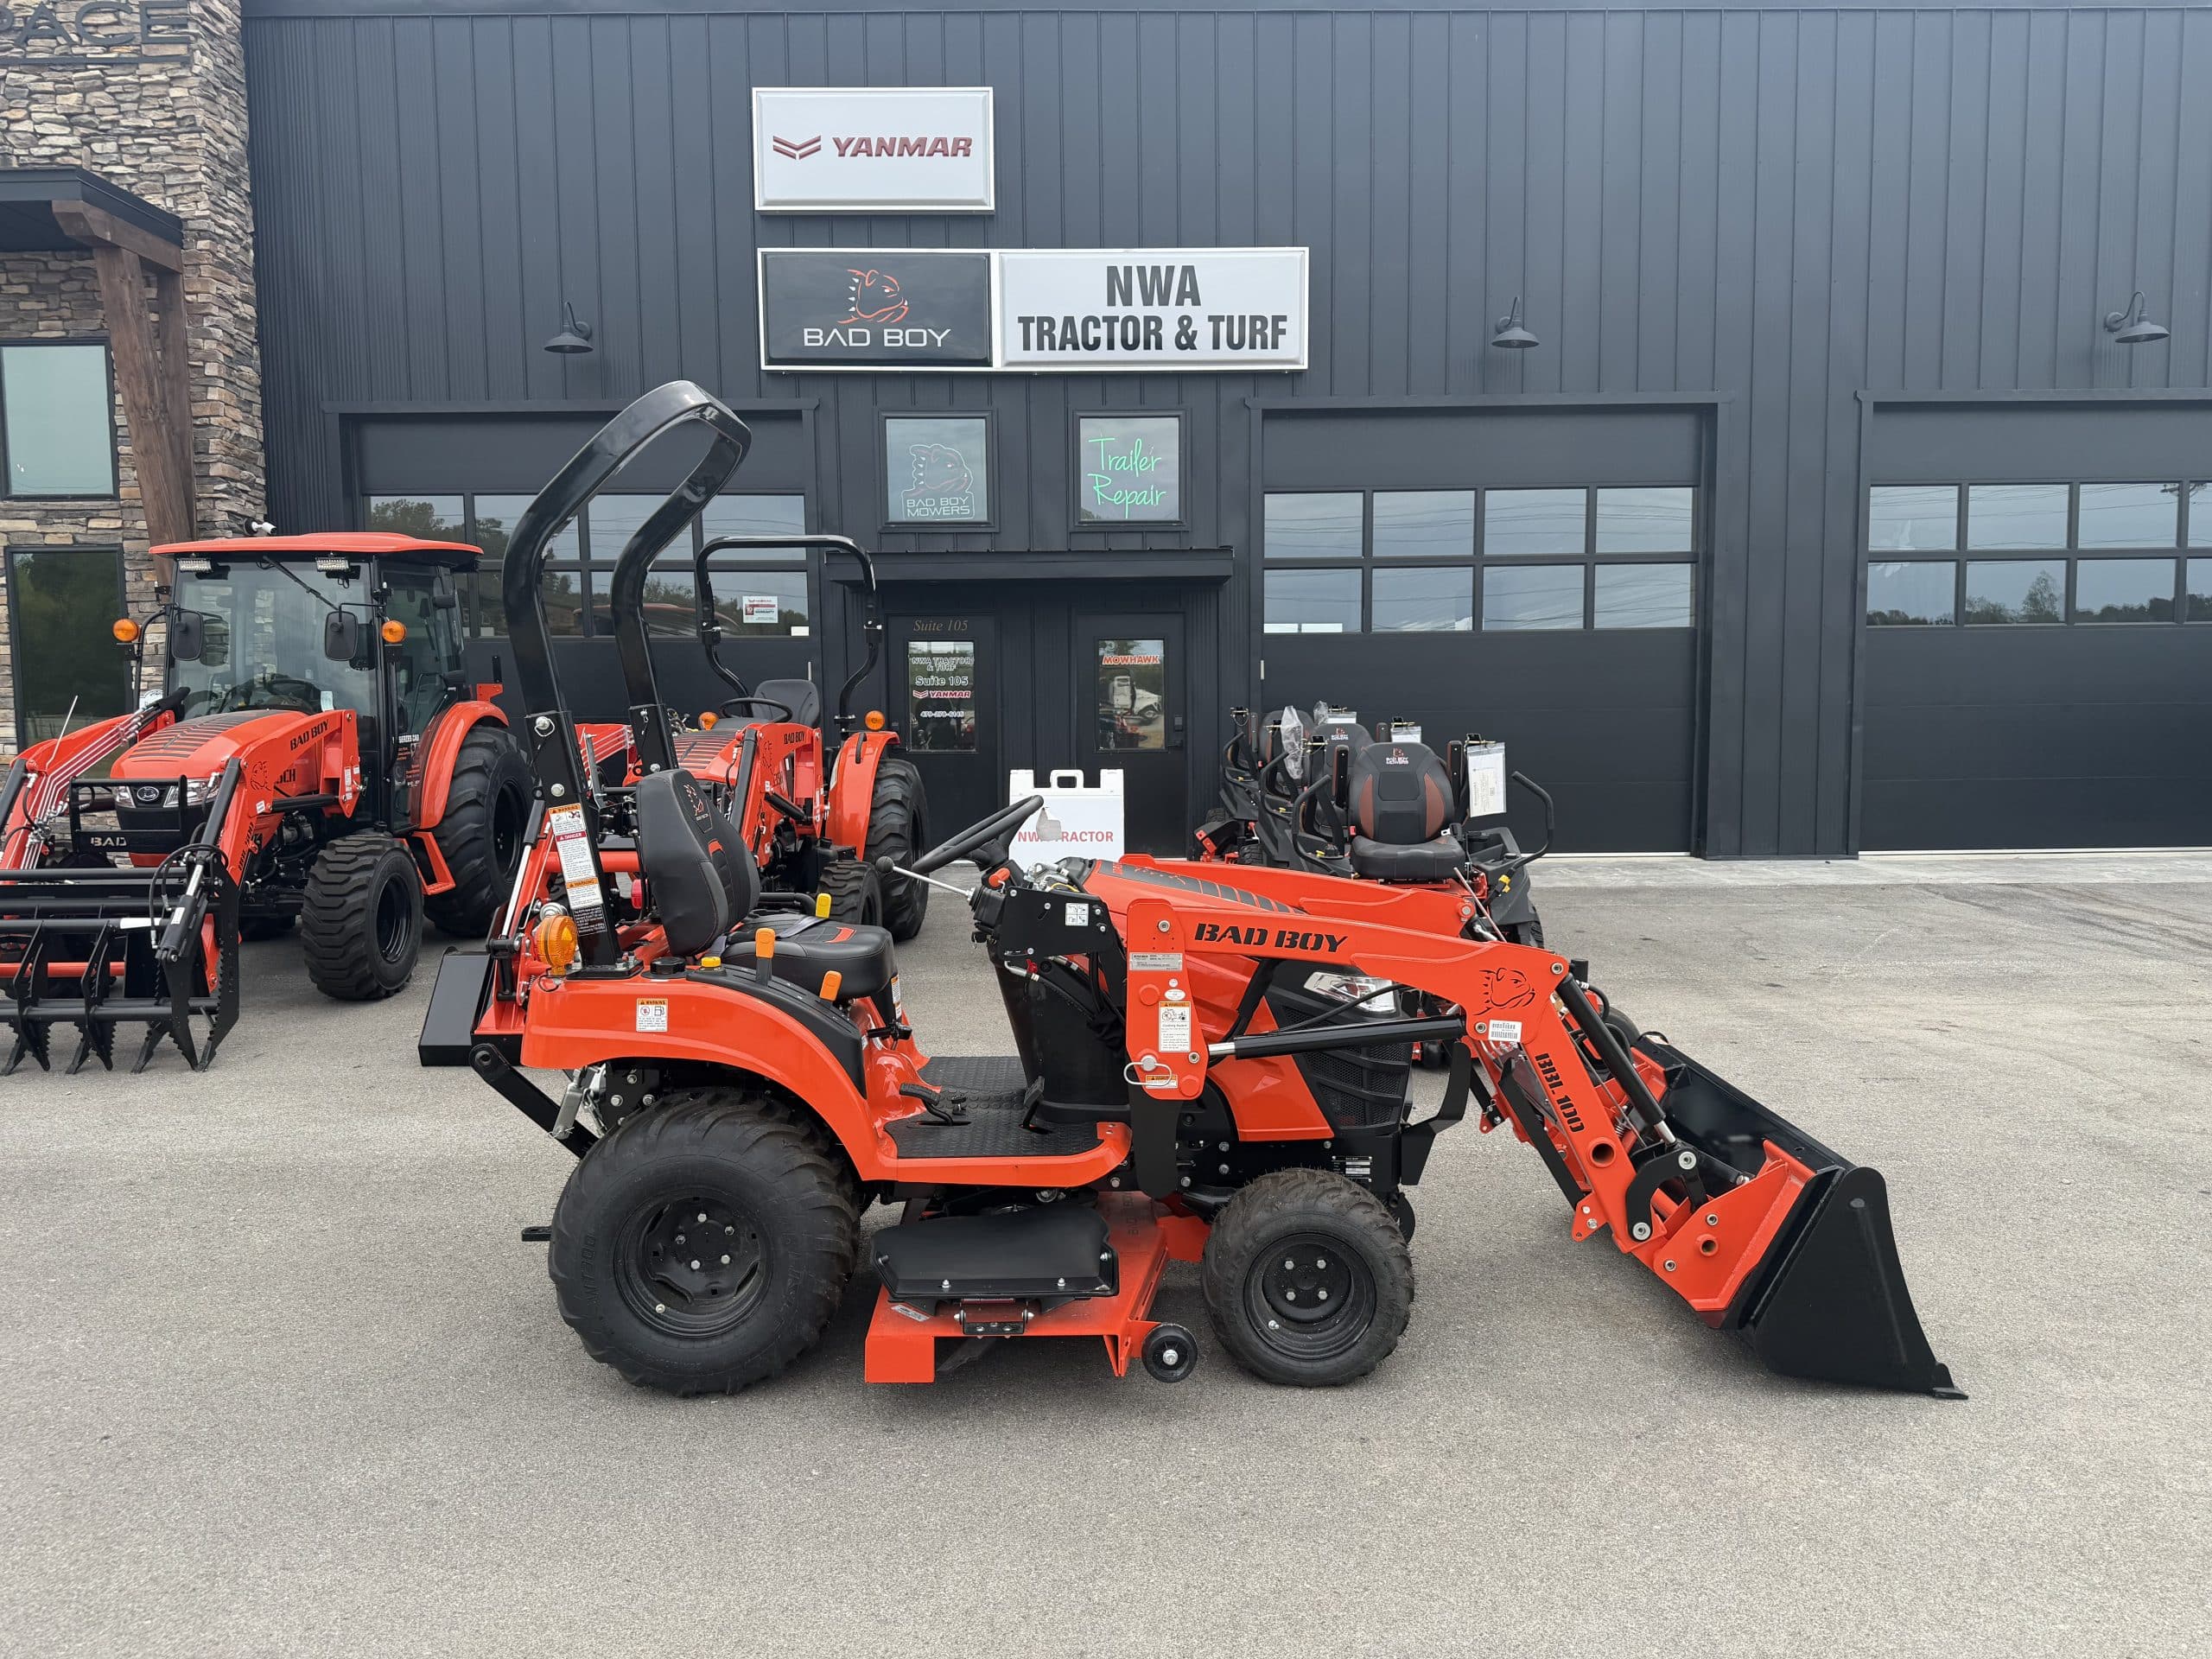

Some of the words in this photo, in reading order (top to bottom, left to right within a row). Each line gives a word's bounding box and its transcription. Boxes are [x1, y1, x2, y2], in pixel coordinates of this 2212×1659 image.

[832, 137, 972, 157] YANMAR
[1107, 265, 1201, 307] NWA
[804, 328, 871, 346] BAD
[883, 328, 950, 347] BOY
[1018, 315, 1163, 351] TRACTOR
[1174, 315, 1198, 350] &
[1208, 315, 1287, 350] TURF
[1088, 437, 1162, 477] Trailer
[906, 498, 935, 507] BAD
[940, 495, 969, 505] BOY
[1087, 473, 1166, 519] Repair
[906, 505, 970, 518] MOWERS
[913, 620, 943, 632] Suite
[947, 620, 969, 632] 105
[933, 657, 974, 665] TRACTOR
[1102, 655, 1160, 664] MOWHAWK
[916, 676, 946, 686] Suite
[949, 676, 969, 686] 105
[930, 690, 971, 699] YANMAR
[290, 731, 309, 751] BAD
[91, 836, 127, 847] BAD
[1194, 923, 1268, 946] BAD
[1274, 930, 1349, 953] BOY
[1556, 1094, 1585, 1133] 100
